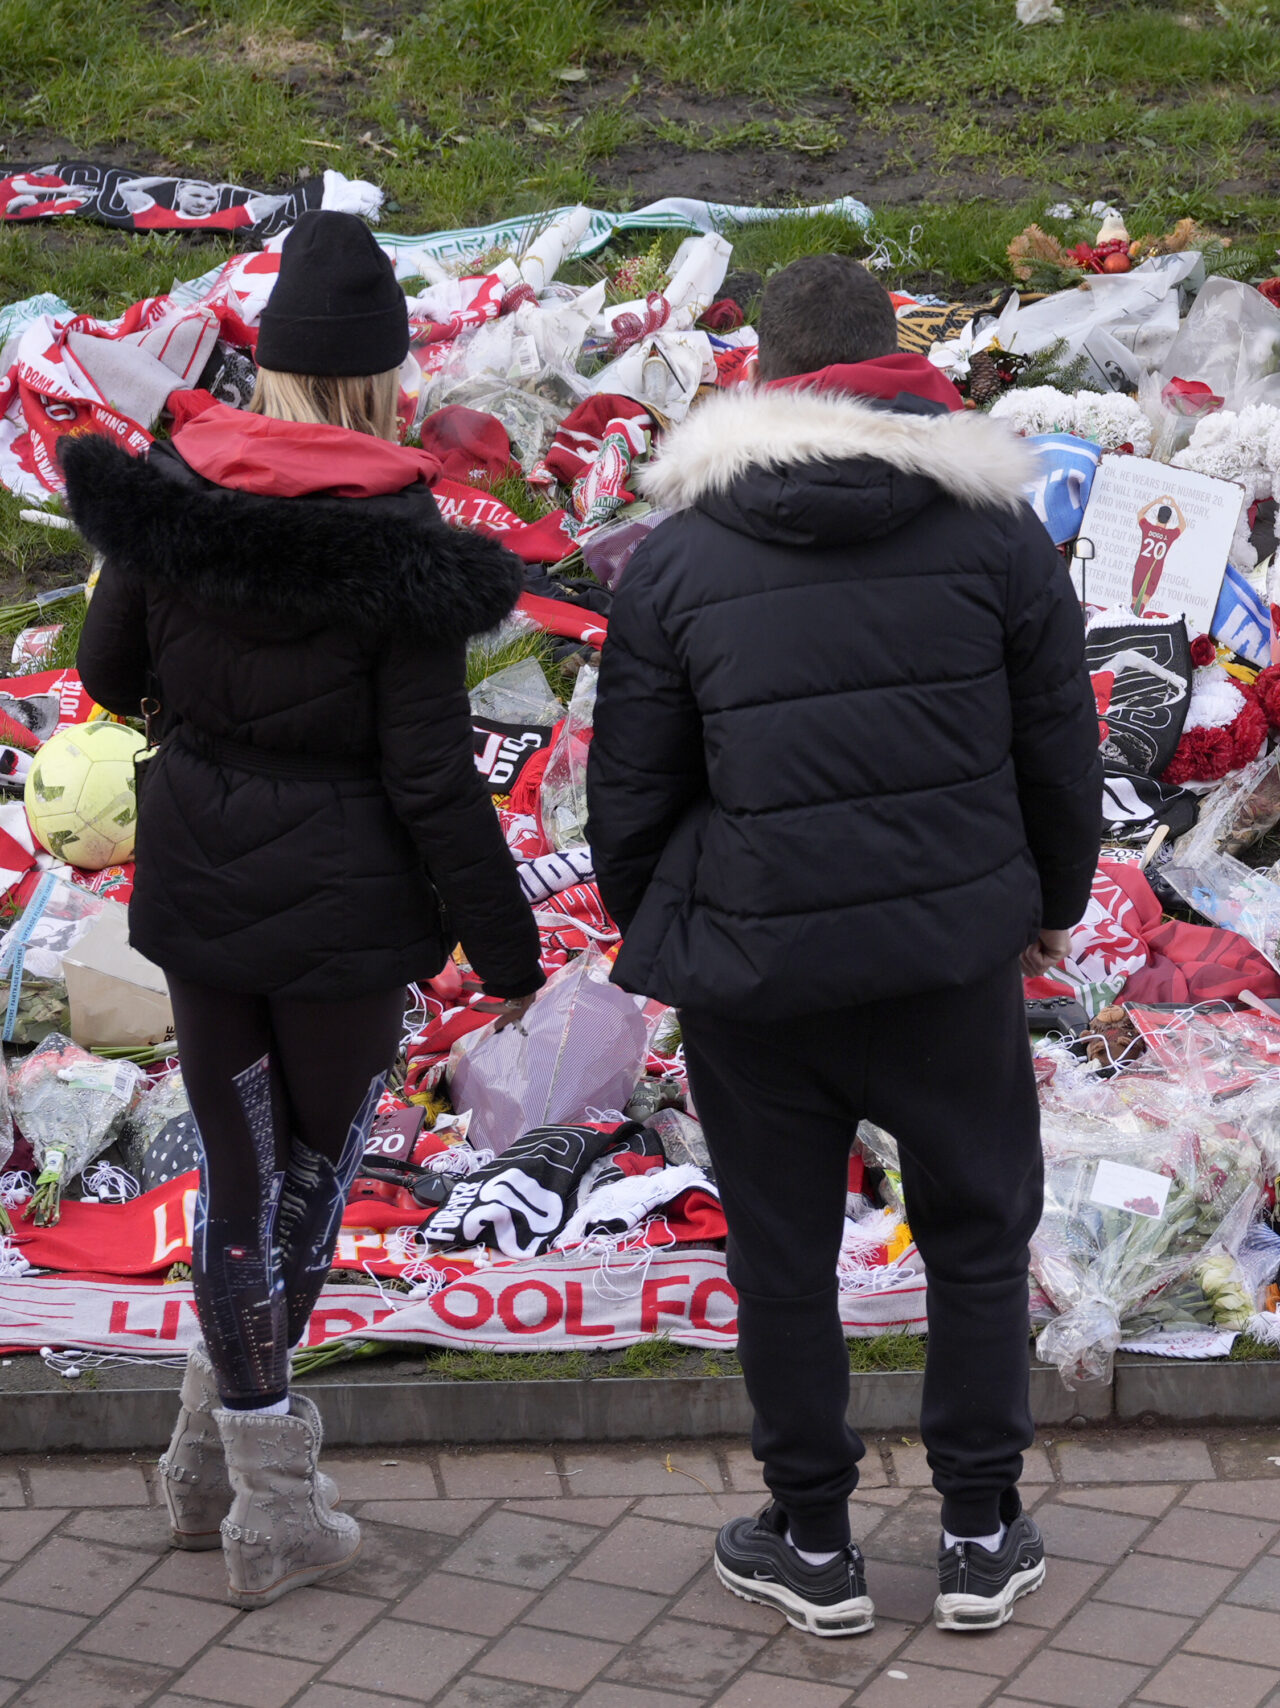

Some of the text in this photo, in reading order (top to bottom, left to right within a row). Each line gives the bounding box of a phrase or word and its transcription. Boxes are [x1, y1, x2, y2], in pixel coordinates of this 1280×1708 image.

[1111, 485, 1132, 496] WILL
[1130, 474, 1161, 488] WEARS
[1160, 482, 1177, 492] THE
[1175, 487, 1212, 501] NUMBER
[1113, 501, 1139, 512] WHEN
[1091, 509, 1135, 527] DOWN THE
[1110, 530, 1127, 540] CUT
[1102, 543, 1129, 556] SCORE
[1139, 538, 1168, 560] 20
[1106, 558, 1124, 569] LAD
[1103, 588, 1128, 601] NAME
[1107, 575, 1128, 586] THAN
[1166, 591, 1183, 600] YOU
[59, 680, 83, 718] JOTA
[1100, 848, 1144, 861] 2025
[15, 947, 24, 977] FLOWERS
[11, 977, 21, 1007] FAIRTRADE
[363, 1132, 405, 1155] 20
[423, 1181, 483, 1242] FOREVER
[462, 1167, 563, 1261] 20
